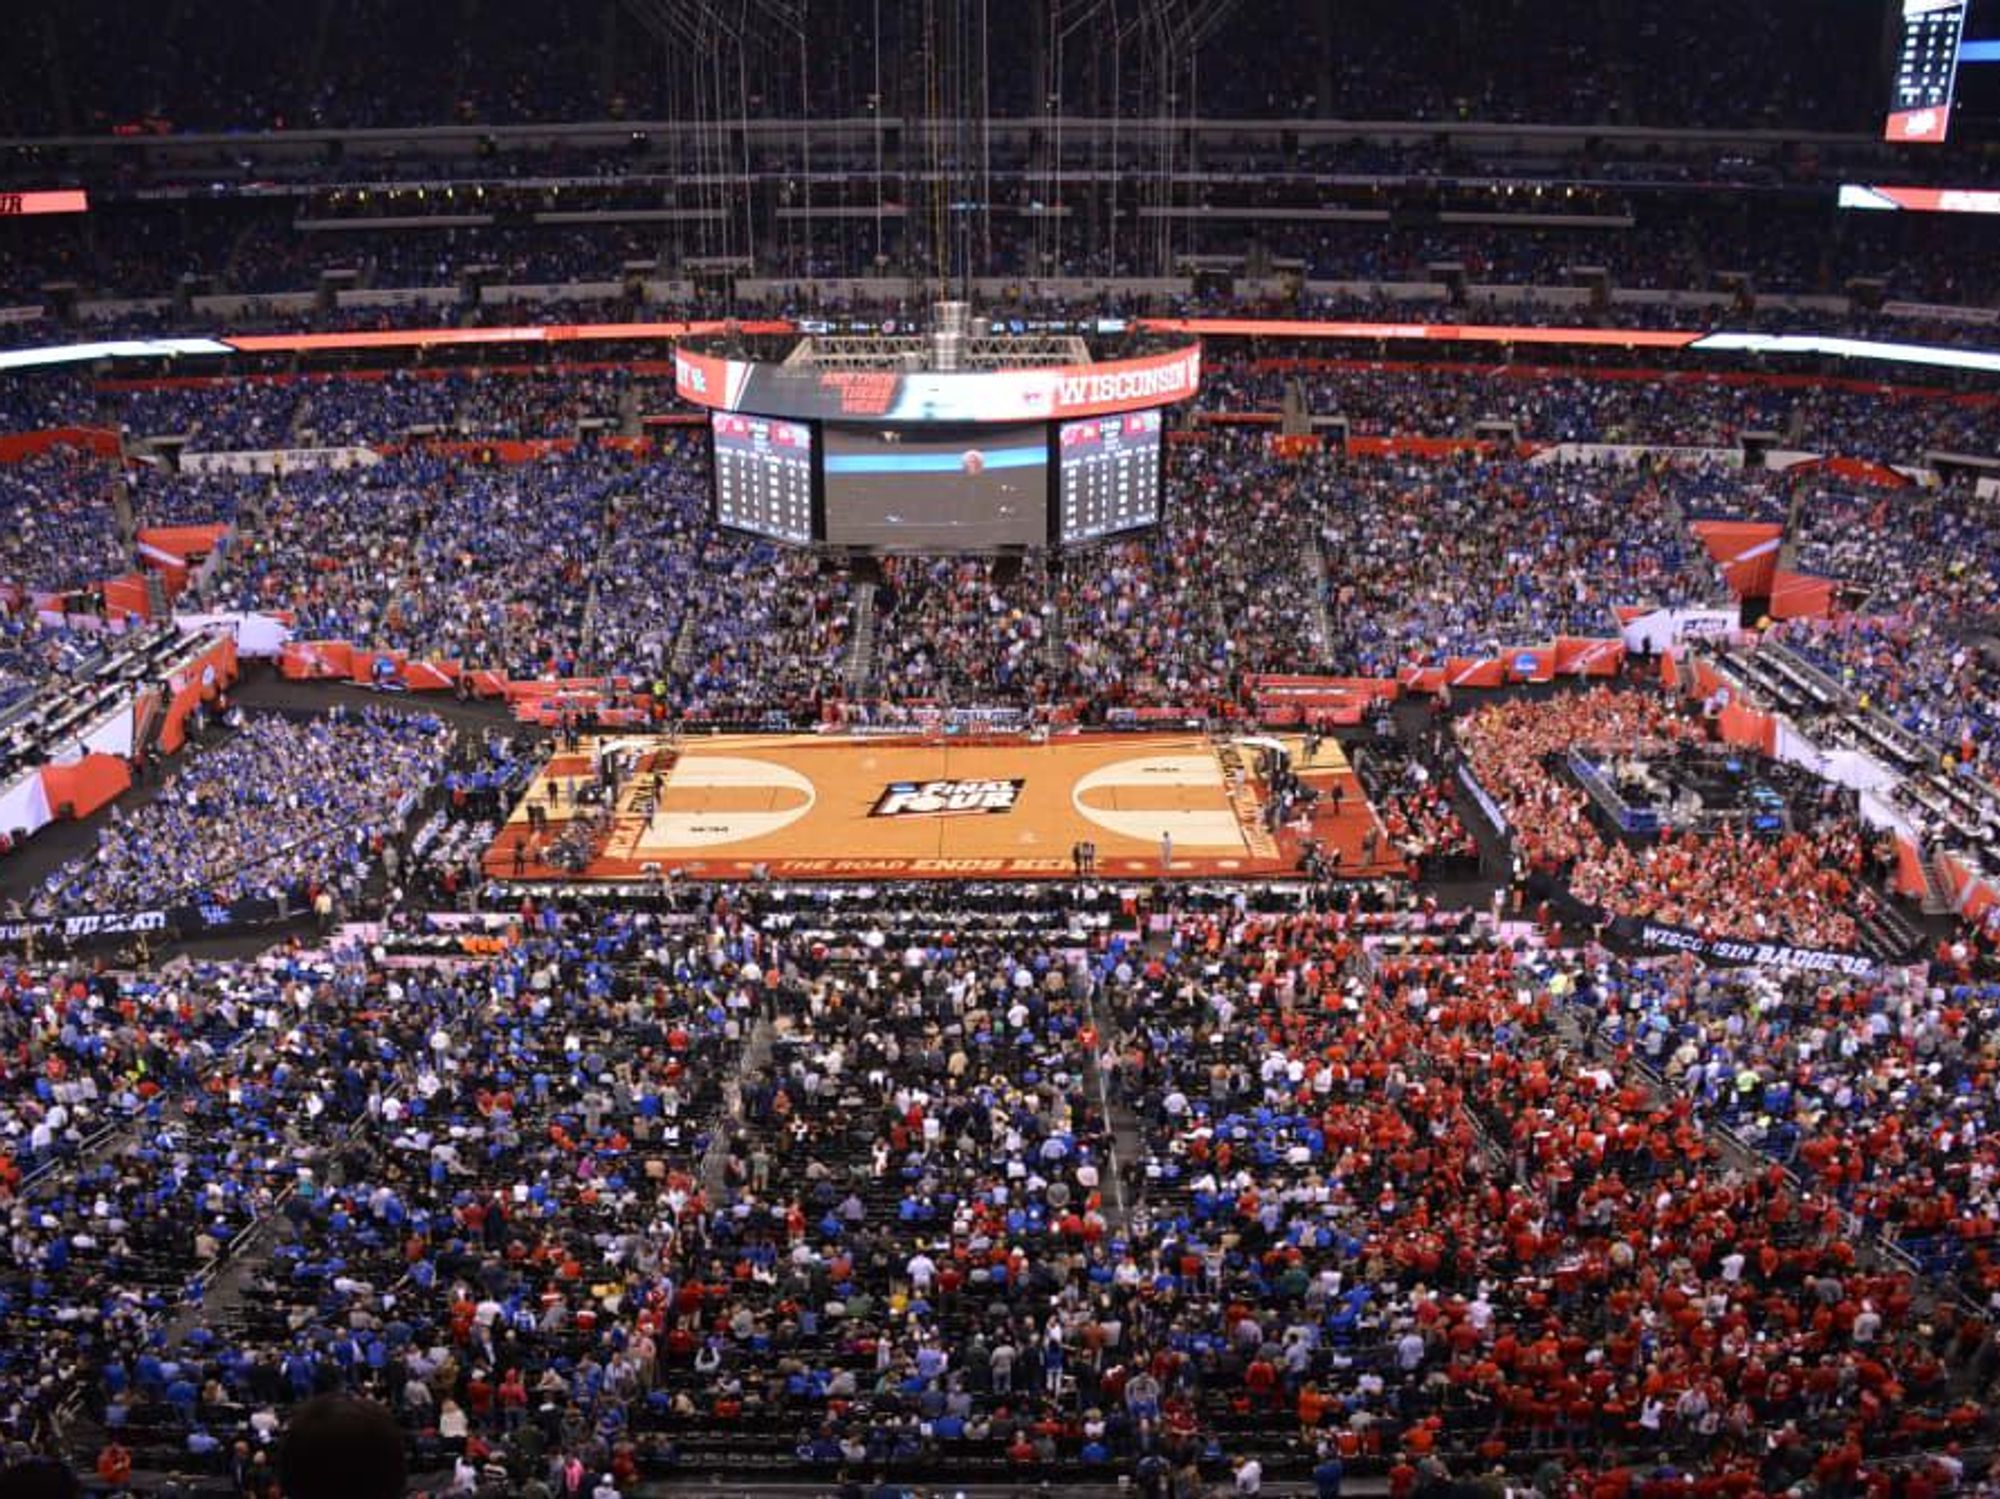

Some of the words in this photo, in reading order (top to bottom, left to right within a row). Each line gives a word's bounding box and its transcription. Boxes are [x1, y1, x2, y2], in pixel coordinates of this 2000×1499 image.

[1053, 358, 1187, 405] WISCONSIN
[922, 779, 1016, 797] FINAL
[881, 791, 1014, 814] FOUR
[782, 859, 831, 870] THE
[835, 859, 907, 870] ROAD
[910, 859, 1003, 871] ENDS
